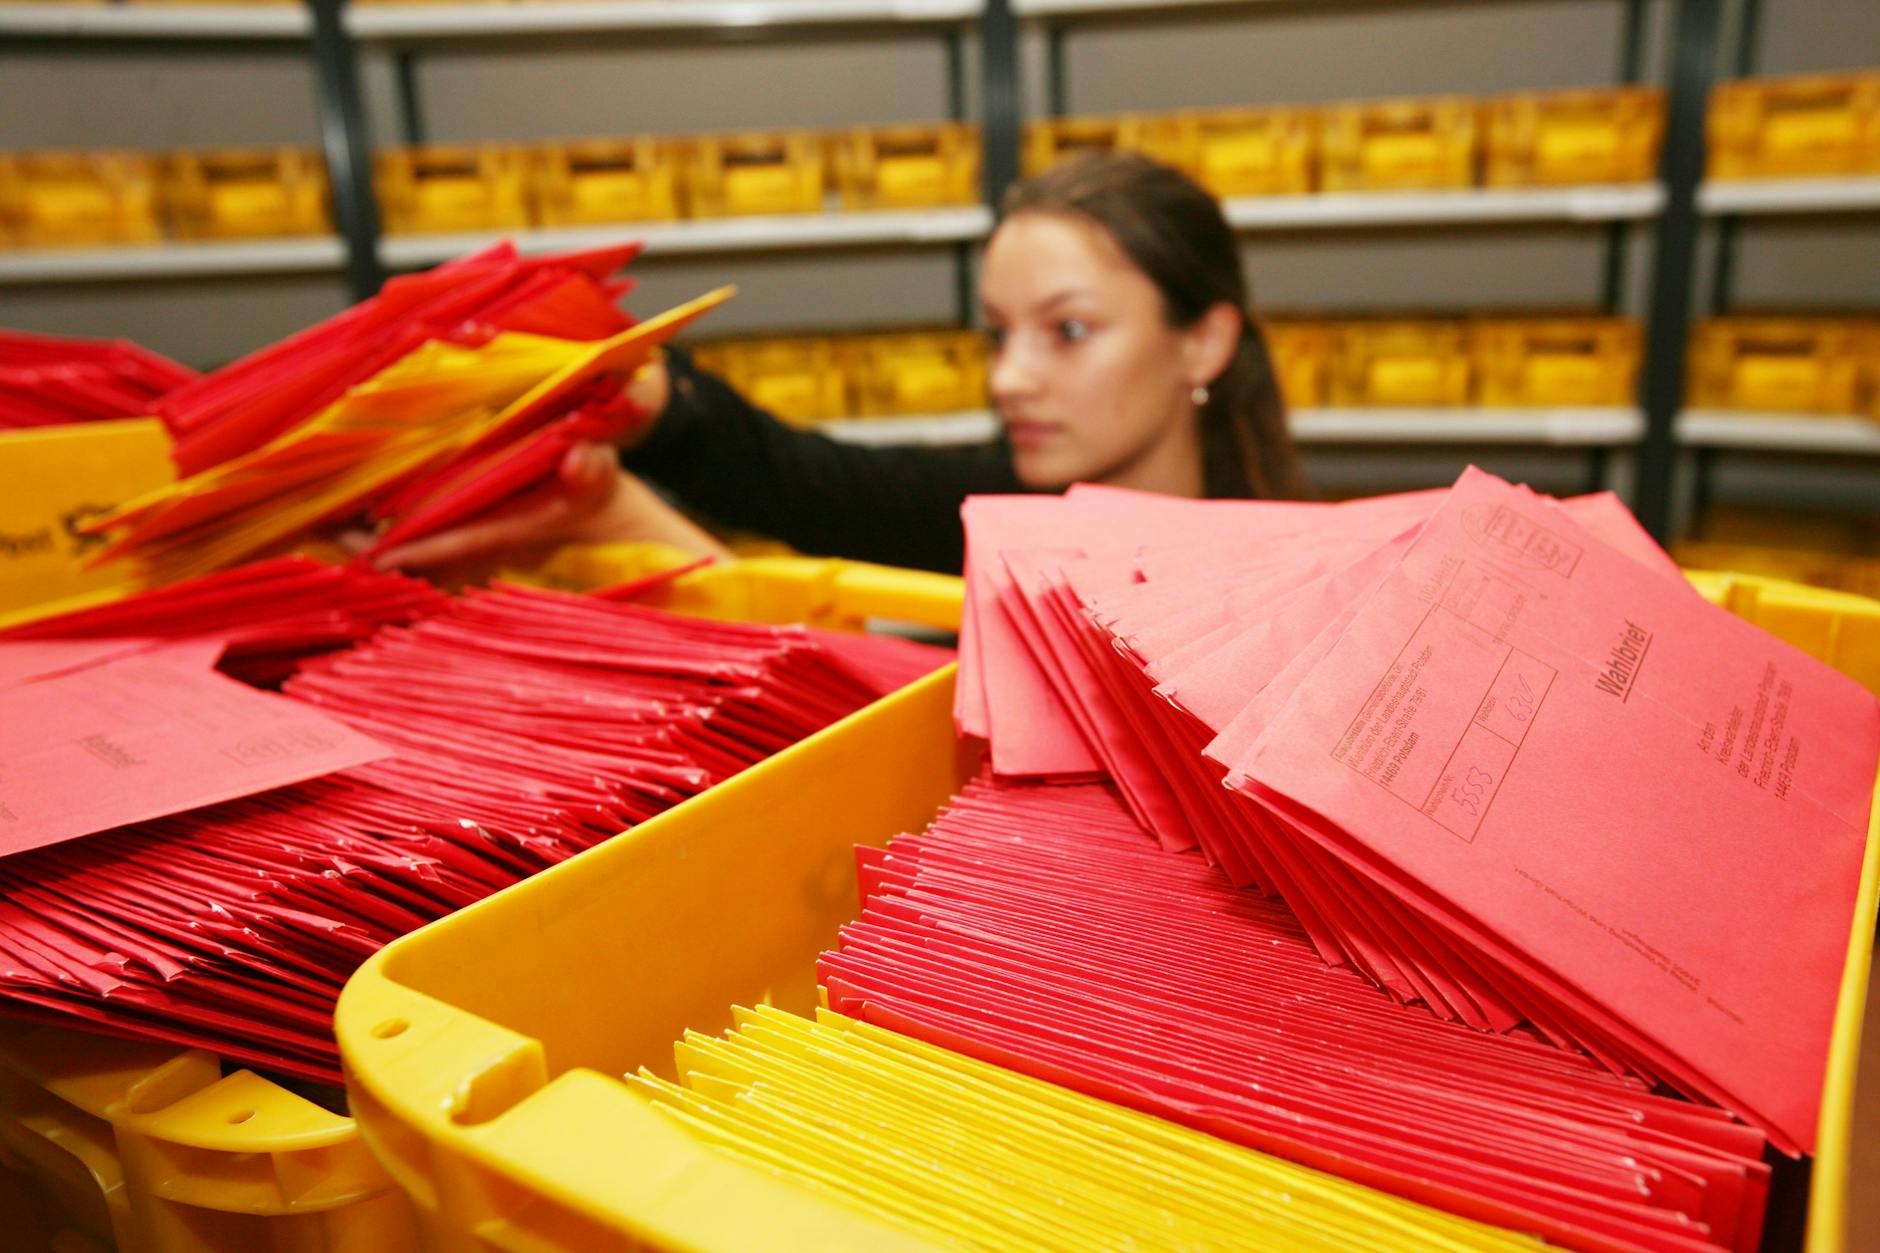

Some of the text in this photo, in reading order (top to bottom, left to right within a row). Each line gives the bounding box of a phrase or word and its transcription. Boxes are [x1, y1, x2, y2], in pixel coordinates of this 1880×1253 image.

[1595, 619, 1647, 697] Wahlbrief
[1378, 729, 1420, 787] 14469 Potsdam
[1452, 766, 1493, 817] 5553
